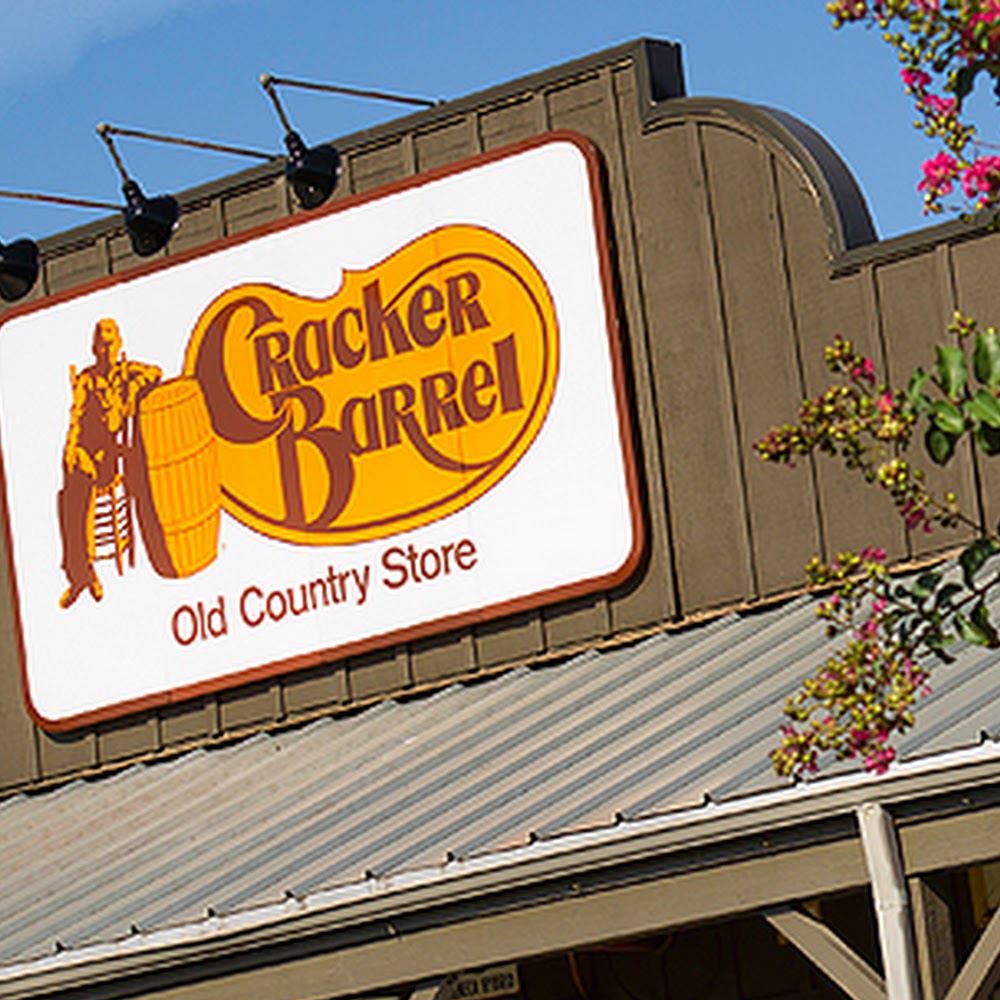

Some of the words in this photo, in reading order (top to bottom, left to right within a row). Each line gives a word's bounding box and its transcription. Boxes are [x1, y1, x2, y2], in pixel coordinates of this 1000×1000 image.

[172, 595, 228, 647] Old
[240, 561, 371, 628] Country
[382, 538, 478, 590] Store
